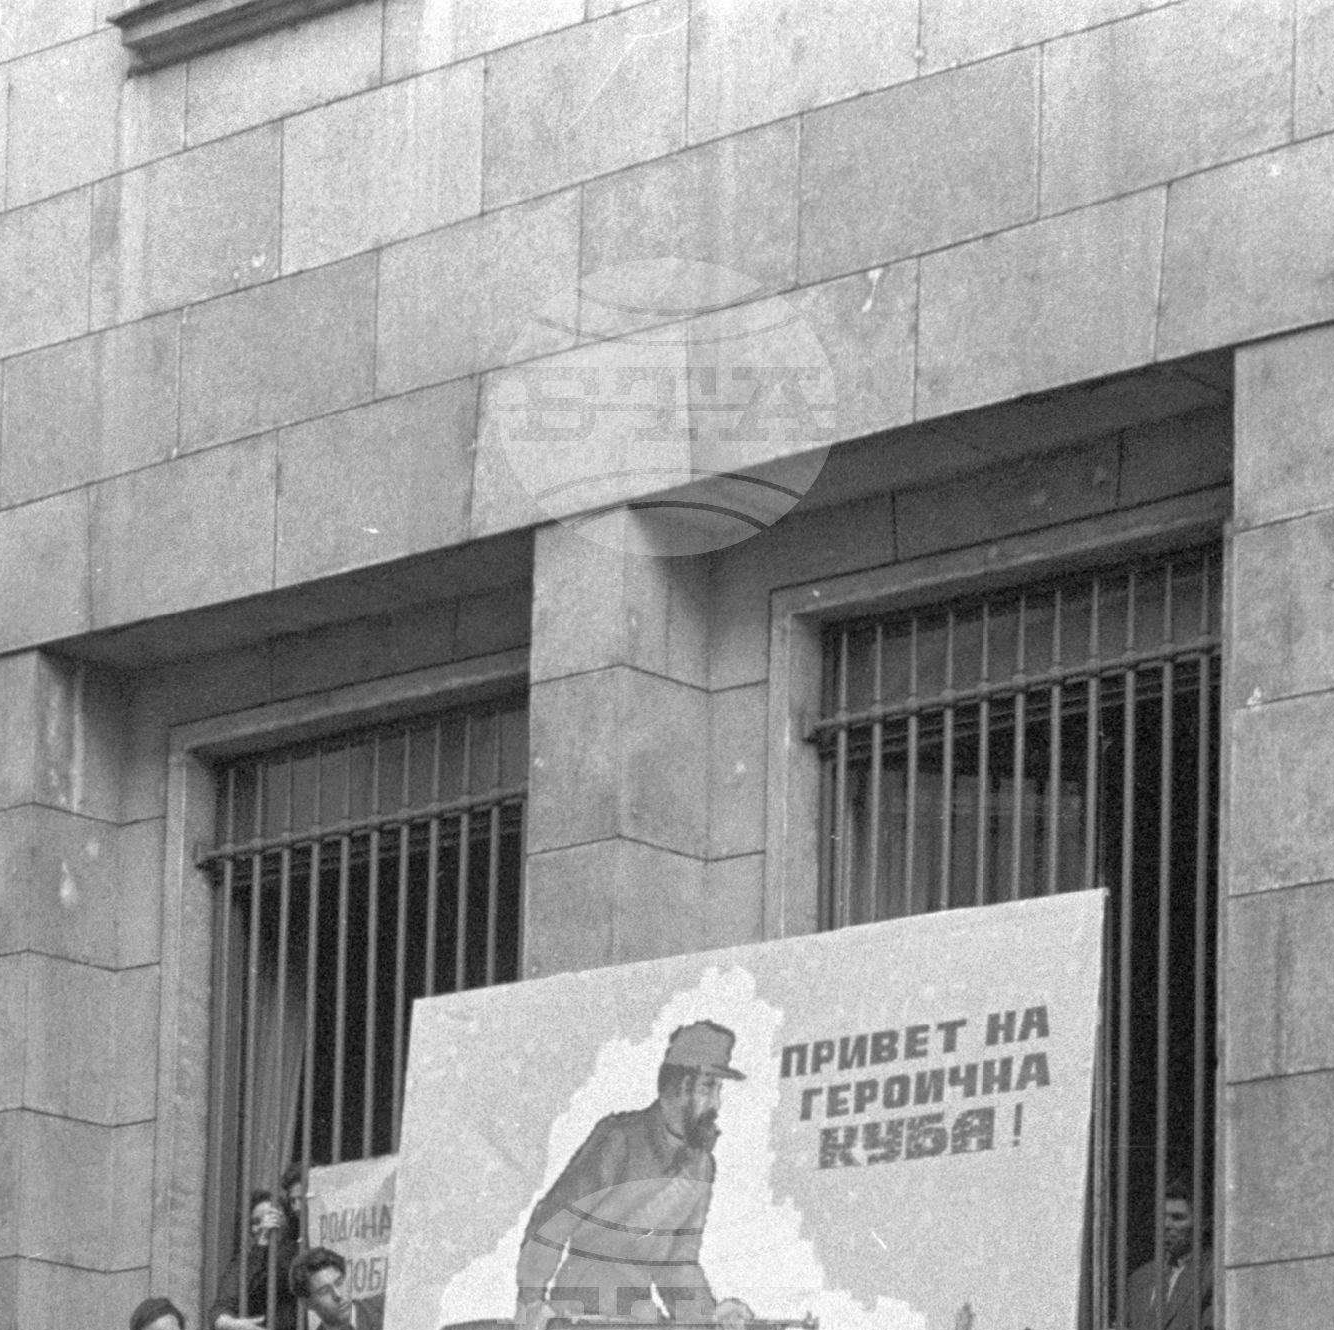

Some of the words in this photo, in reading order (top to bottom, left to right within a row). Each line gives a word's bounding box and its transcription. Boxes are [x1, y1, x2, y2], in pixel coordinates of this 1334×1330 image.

[781, 1019, 967, 1078] ПРИВЕТ
[985, 1005, 1050, 1046] НА
[799, 1052, 1051, 1122] ГЕРОИЧНА
[319, 1205, 393, 1244] РОДИНА
